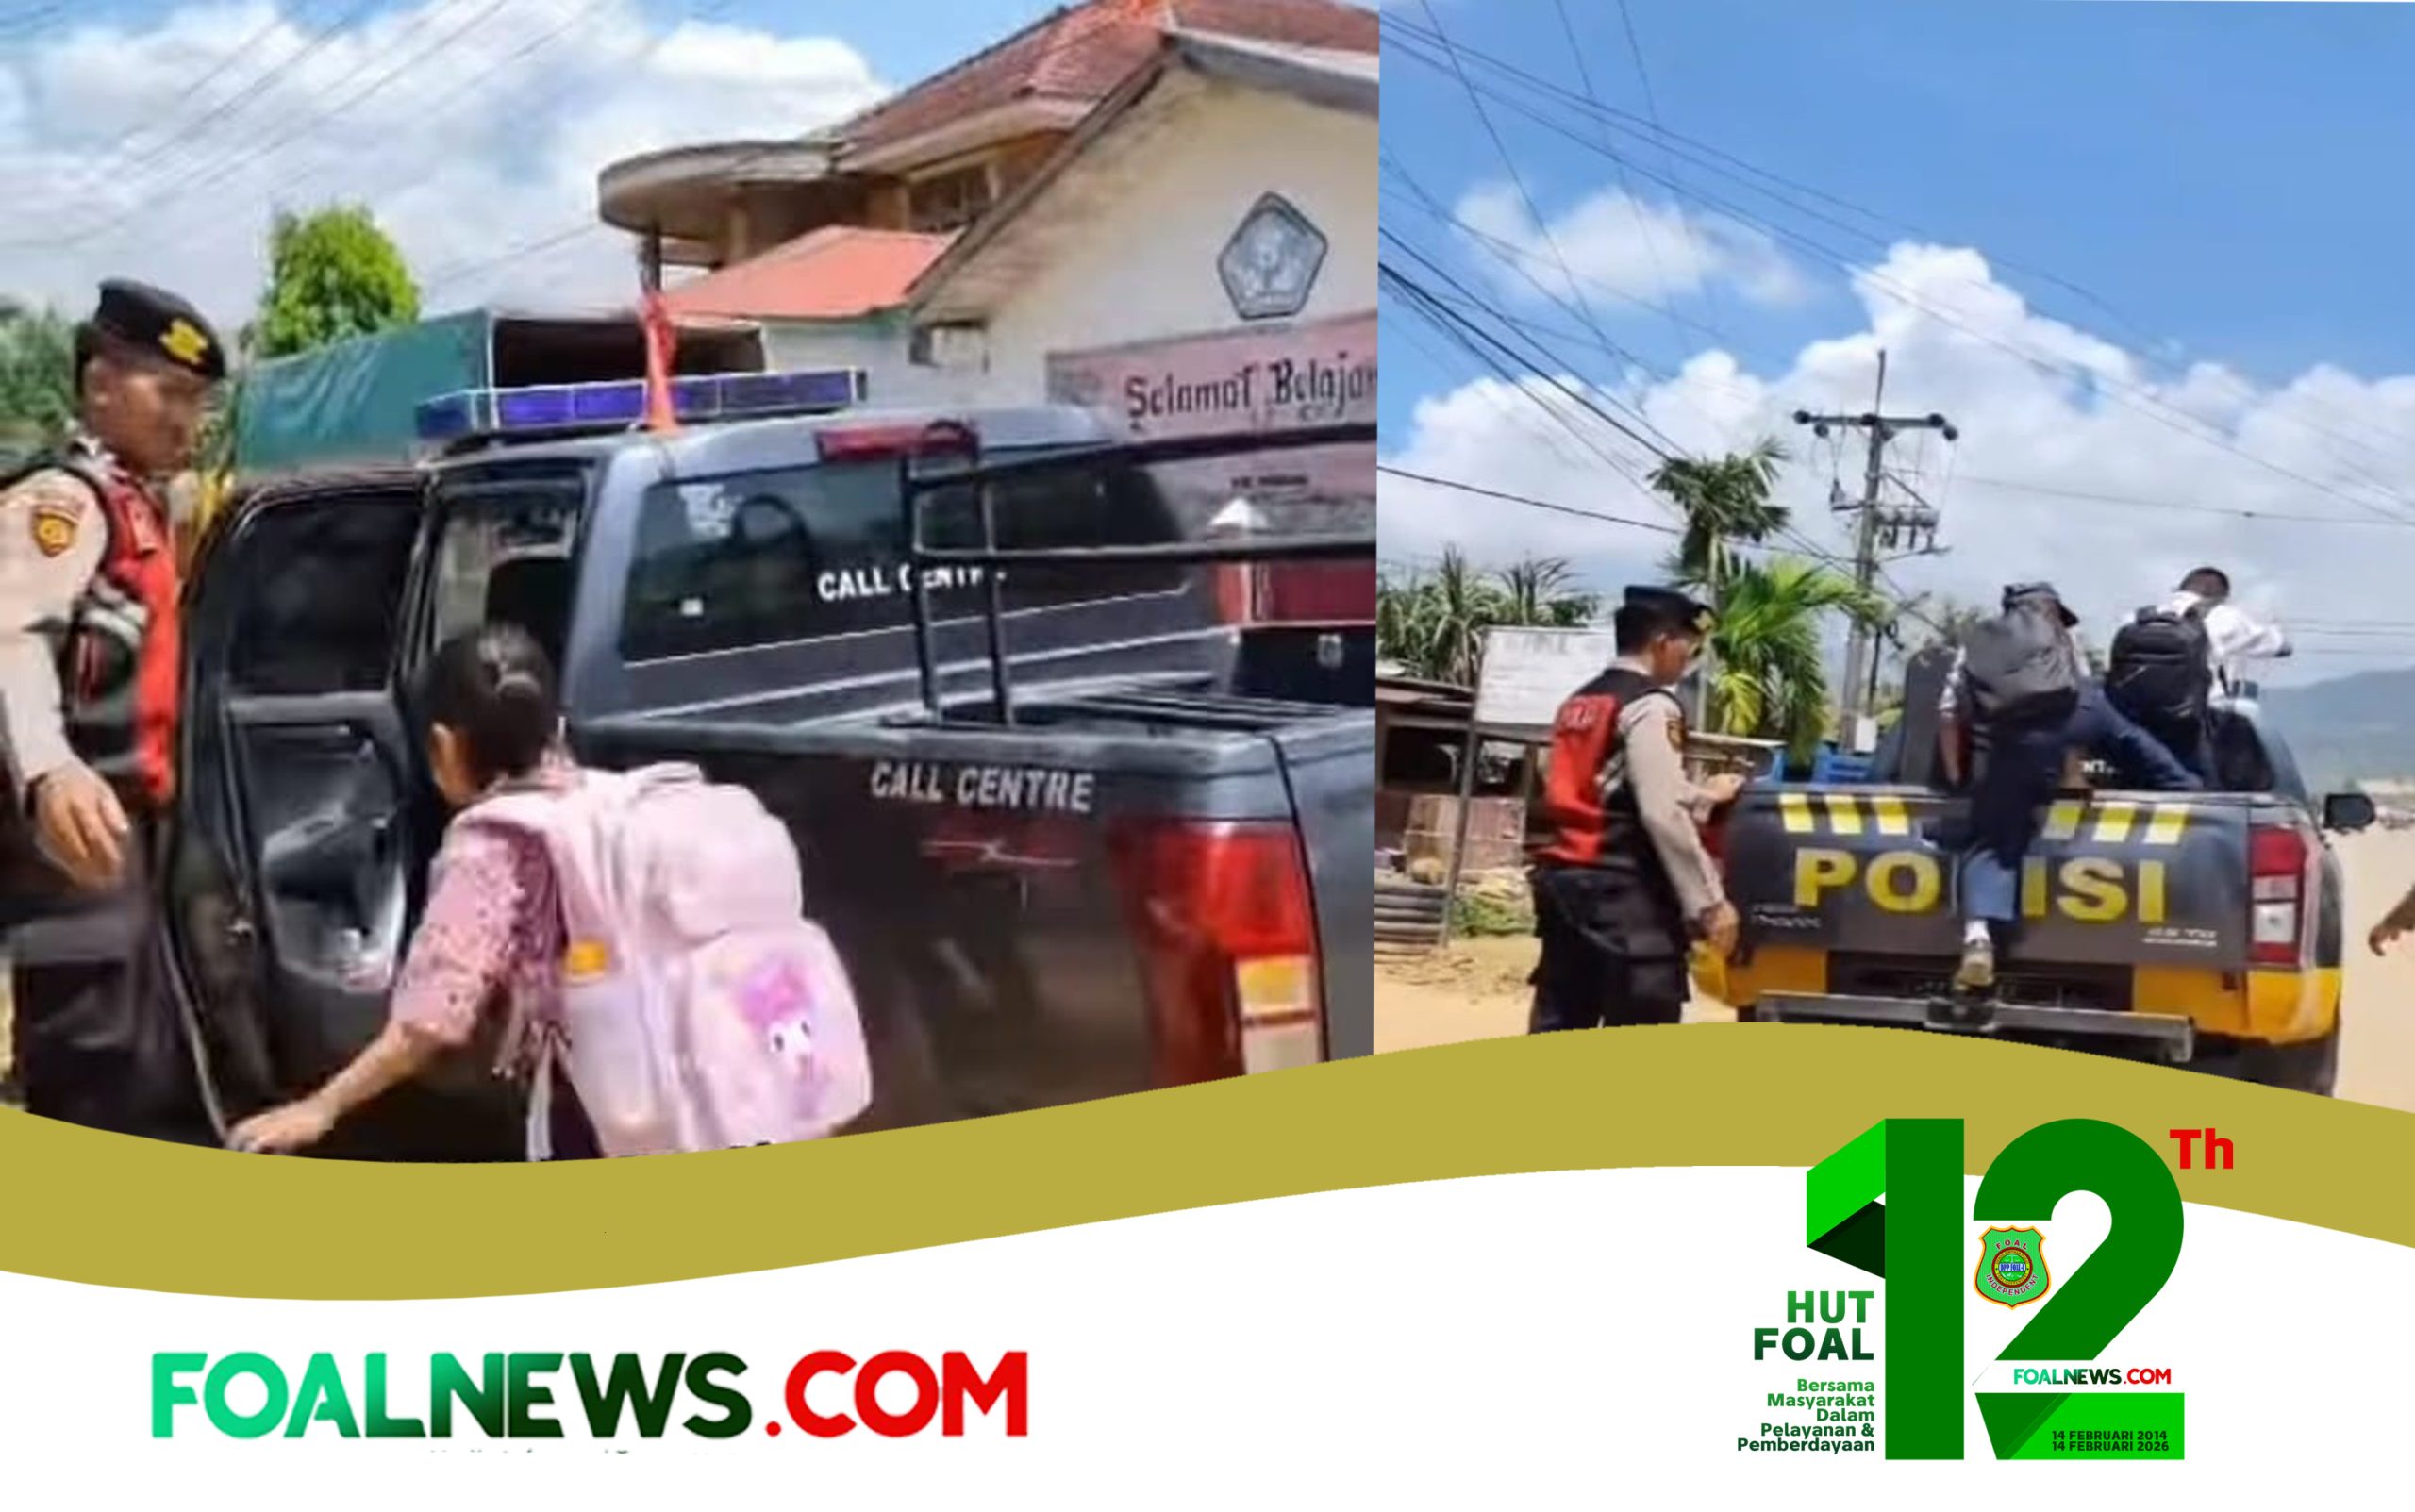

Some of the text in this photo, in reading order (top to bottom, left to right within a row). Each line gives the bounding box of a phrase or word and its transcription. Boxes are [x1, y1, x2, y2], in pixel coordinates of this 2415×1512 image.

[1124, 363, 1257, 419] Selamat
[817, 563, 1007, 601] CALL CENT
[871, 761, 1095, 813] CALL CENTRE
[1794, 847, 2165, 923] POISI
